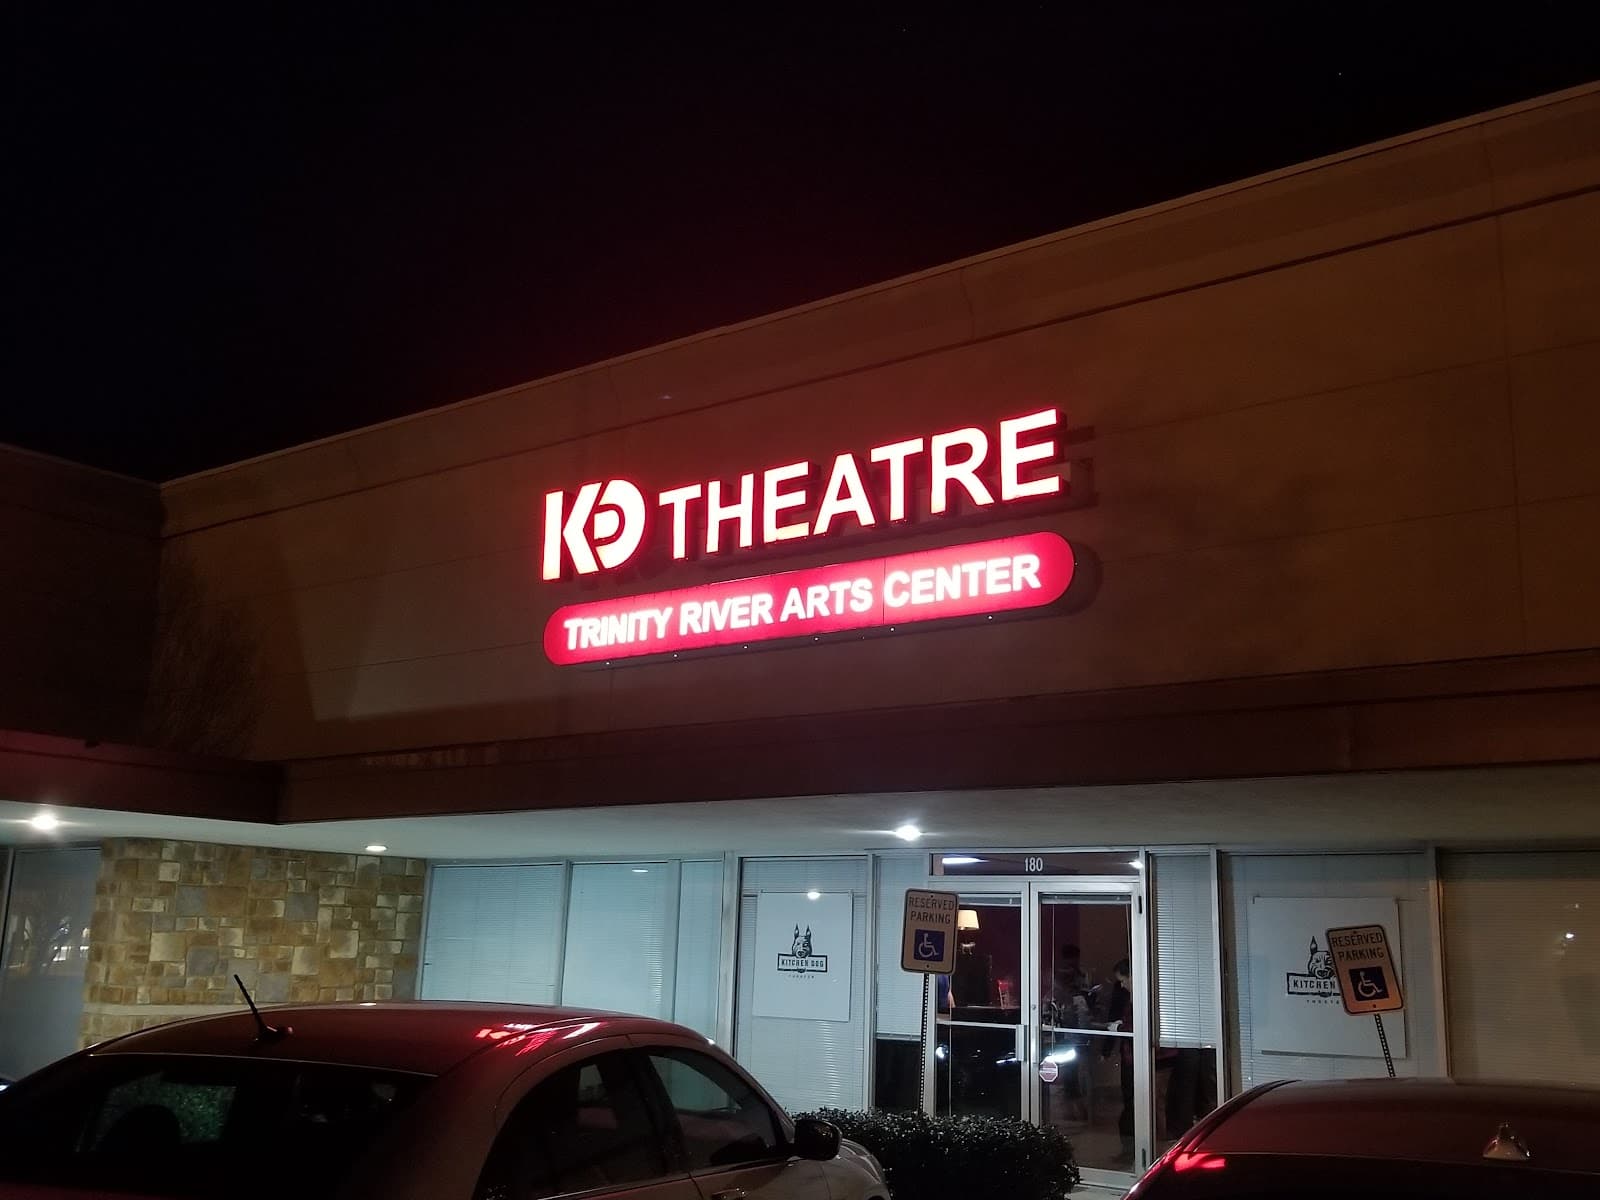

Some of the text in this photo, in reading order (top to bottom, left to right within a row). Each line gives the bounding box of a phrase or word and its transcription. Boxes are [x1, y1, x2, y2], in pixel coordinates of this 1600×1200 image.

[543, 409, 1060, 580] KD THEATRE
[564, 554, 1042, 650] TRINITY RIVER ARTS CENTER
[1025, 857, 1043, 871] 180
[908, 896, 955, 911] RESERVED
[910, 910, 951, 925] PARKING
[1331, 932, 1383, 948] RESERVED
[1338, 947, 1385, 961] PARKING
[781, 959, 809, 967] KITCHEN
[1293, 979, 1336, 990] KITCHEN
